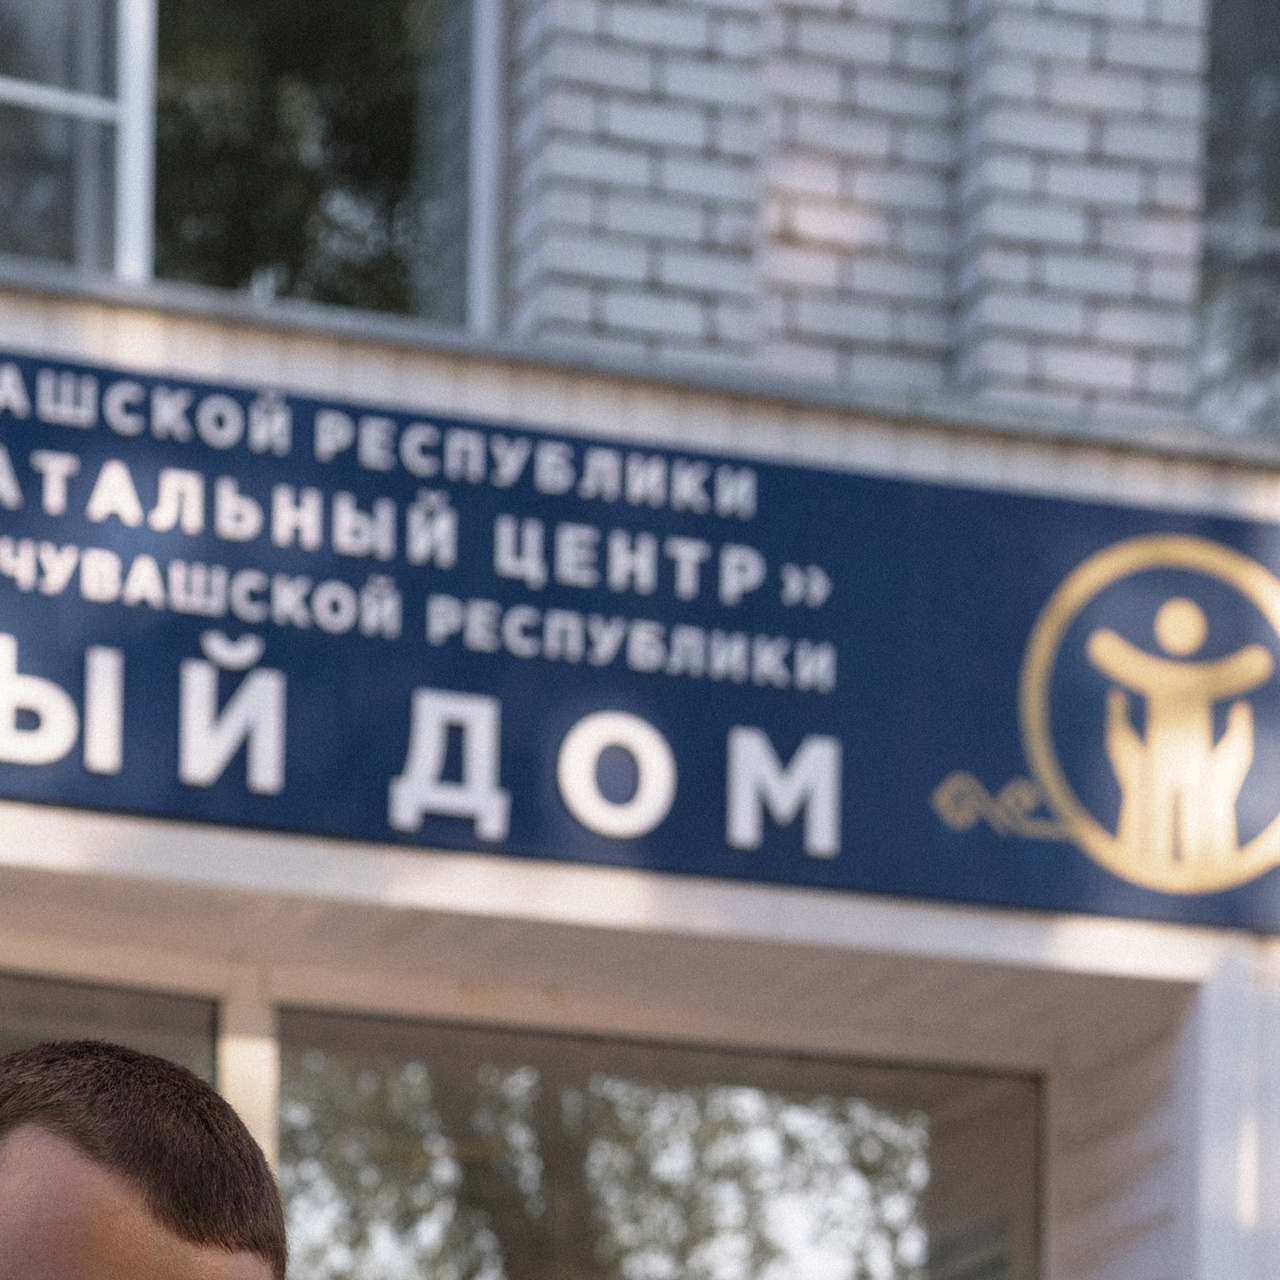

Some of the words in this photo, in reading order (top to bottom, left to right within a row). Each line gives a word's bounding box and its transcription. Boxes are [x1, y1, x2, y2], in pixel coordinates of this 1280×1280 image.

[314, 411, 757, 517] РЕСПУБЛИКИ
[493, 516, 832, 610] ЦЕНТР»
[426, 594, 837, 693] РЕСПУБЛИКИ
[388, 688, 841, 857] ДОМ
